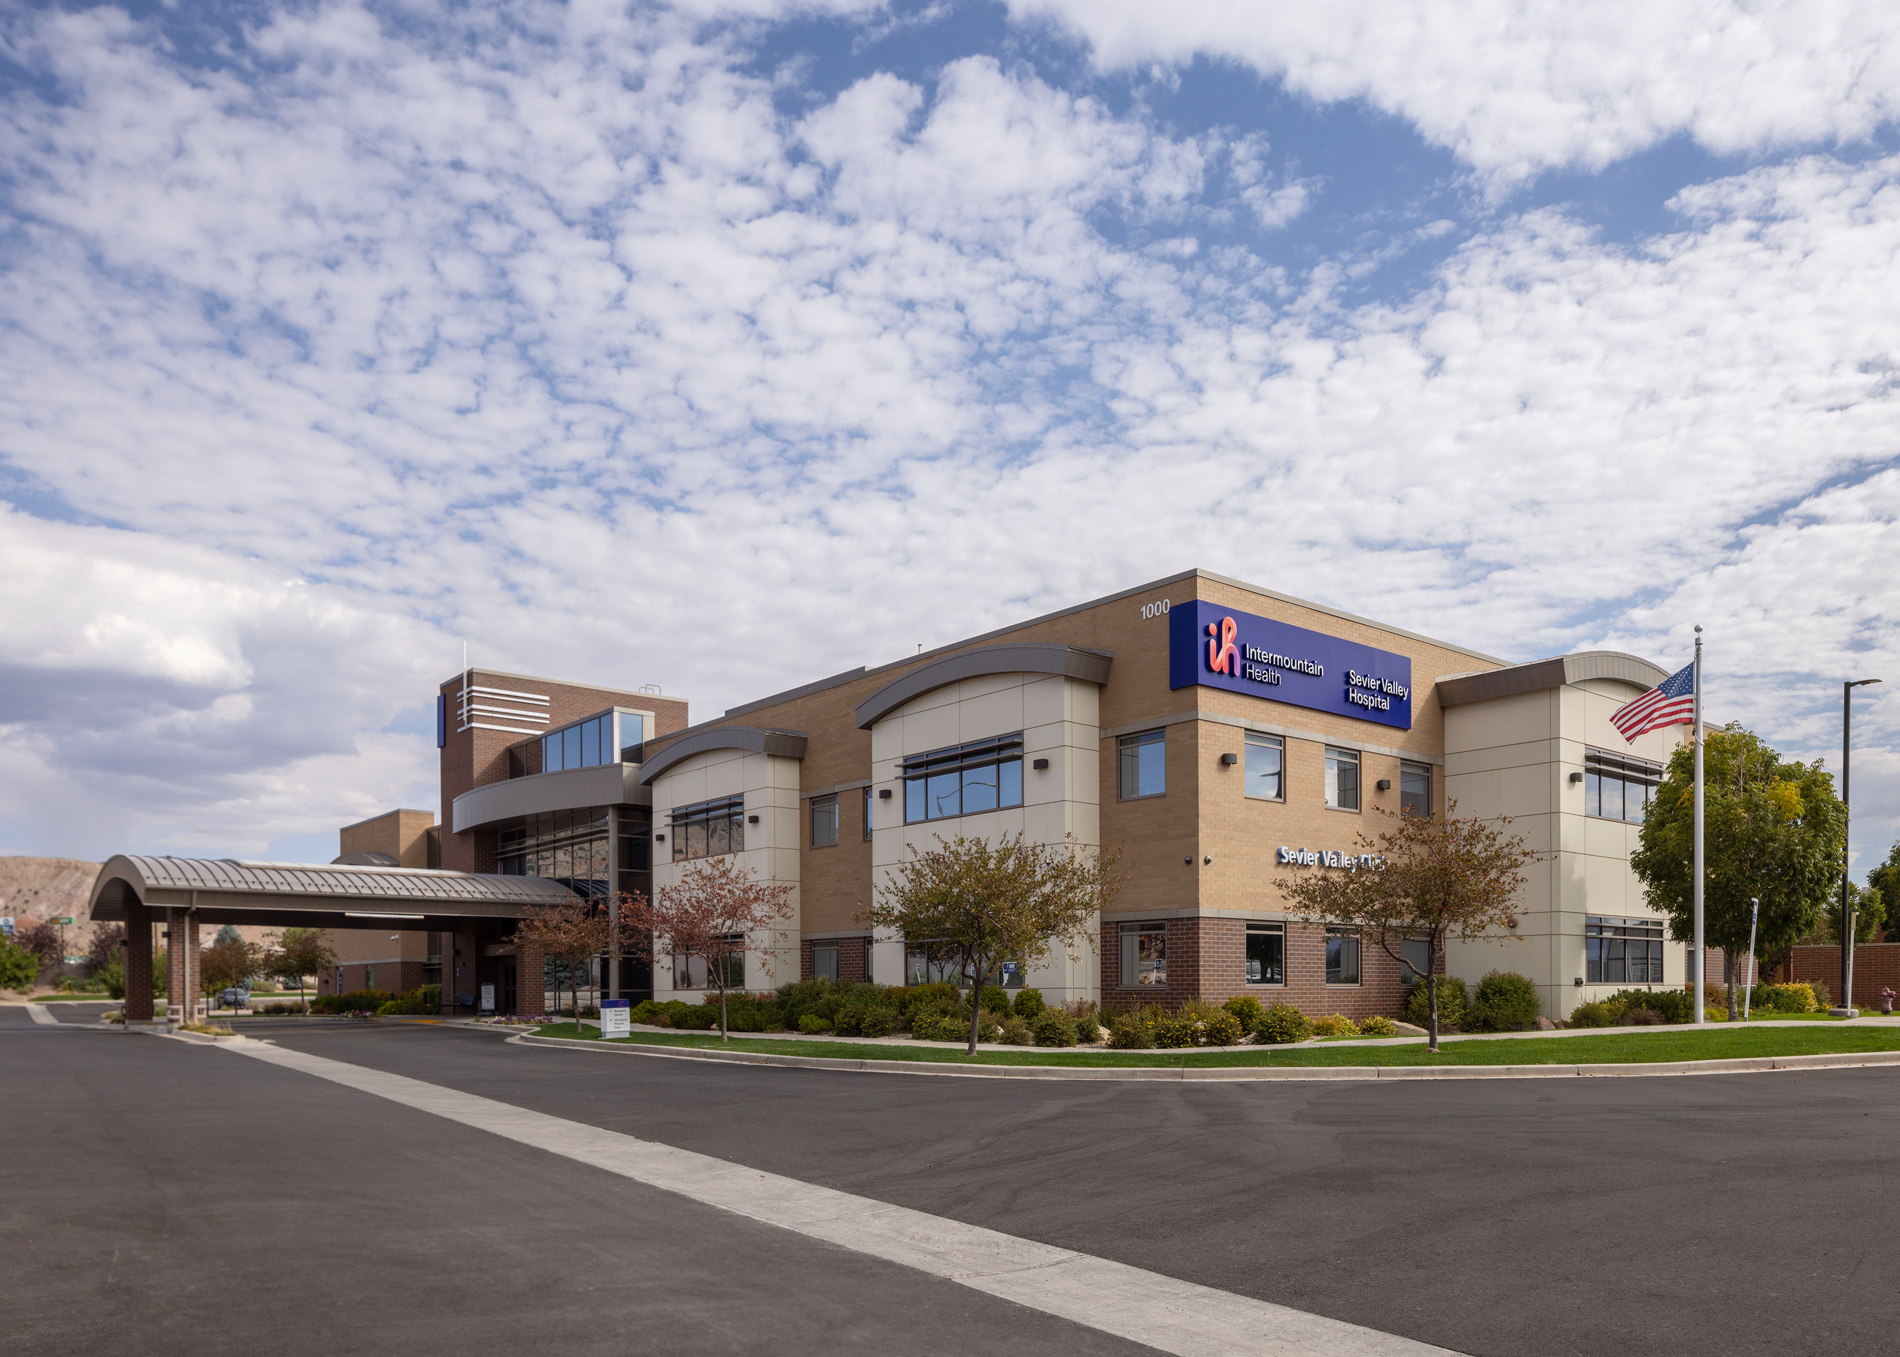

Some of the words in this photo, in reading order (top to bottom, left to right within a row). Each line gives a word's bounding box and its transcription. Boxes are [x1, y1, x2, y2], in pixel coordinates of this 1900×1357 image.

[1140, 598, 1171, 620] 1000
[1246, 643, 1324, 677] Intermountain
[1246, 662, 1282, 686] Health
[1349, 669, 1381, 690] Sevier
[1381, 677, 1409, 701] Valley
[1349, 687, 1390, 711] Hospital
[1278, 846, 1320, 866] Sevier
